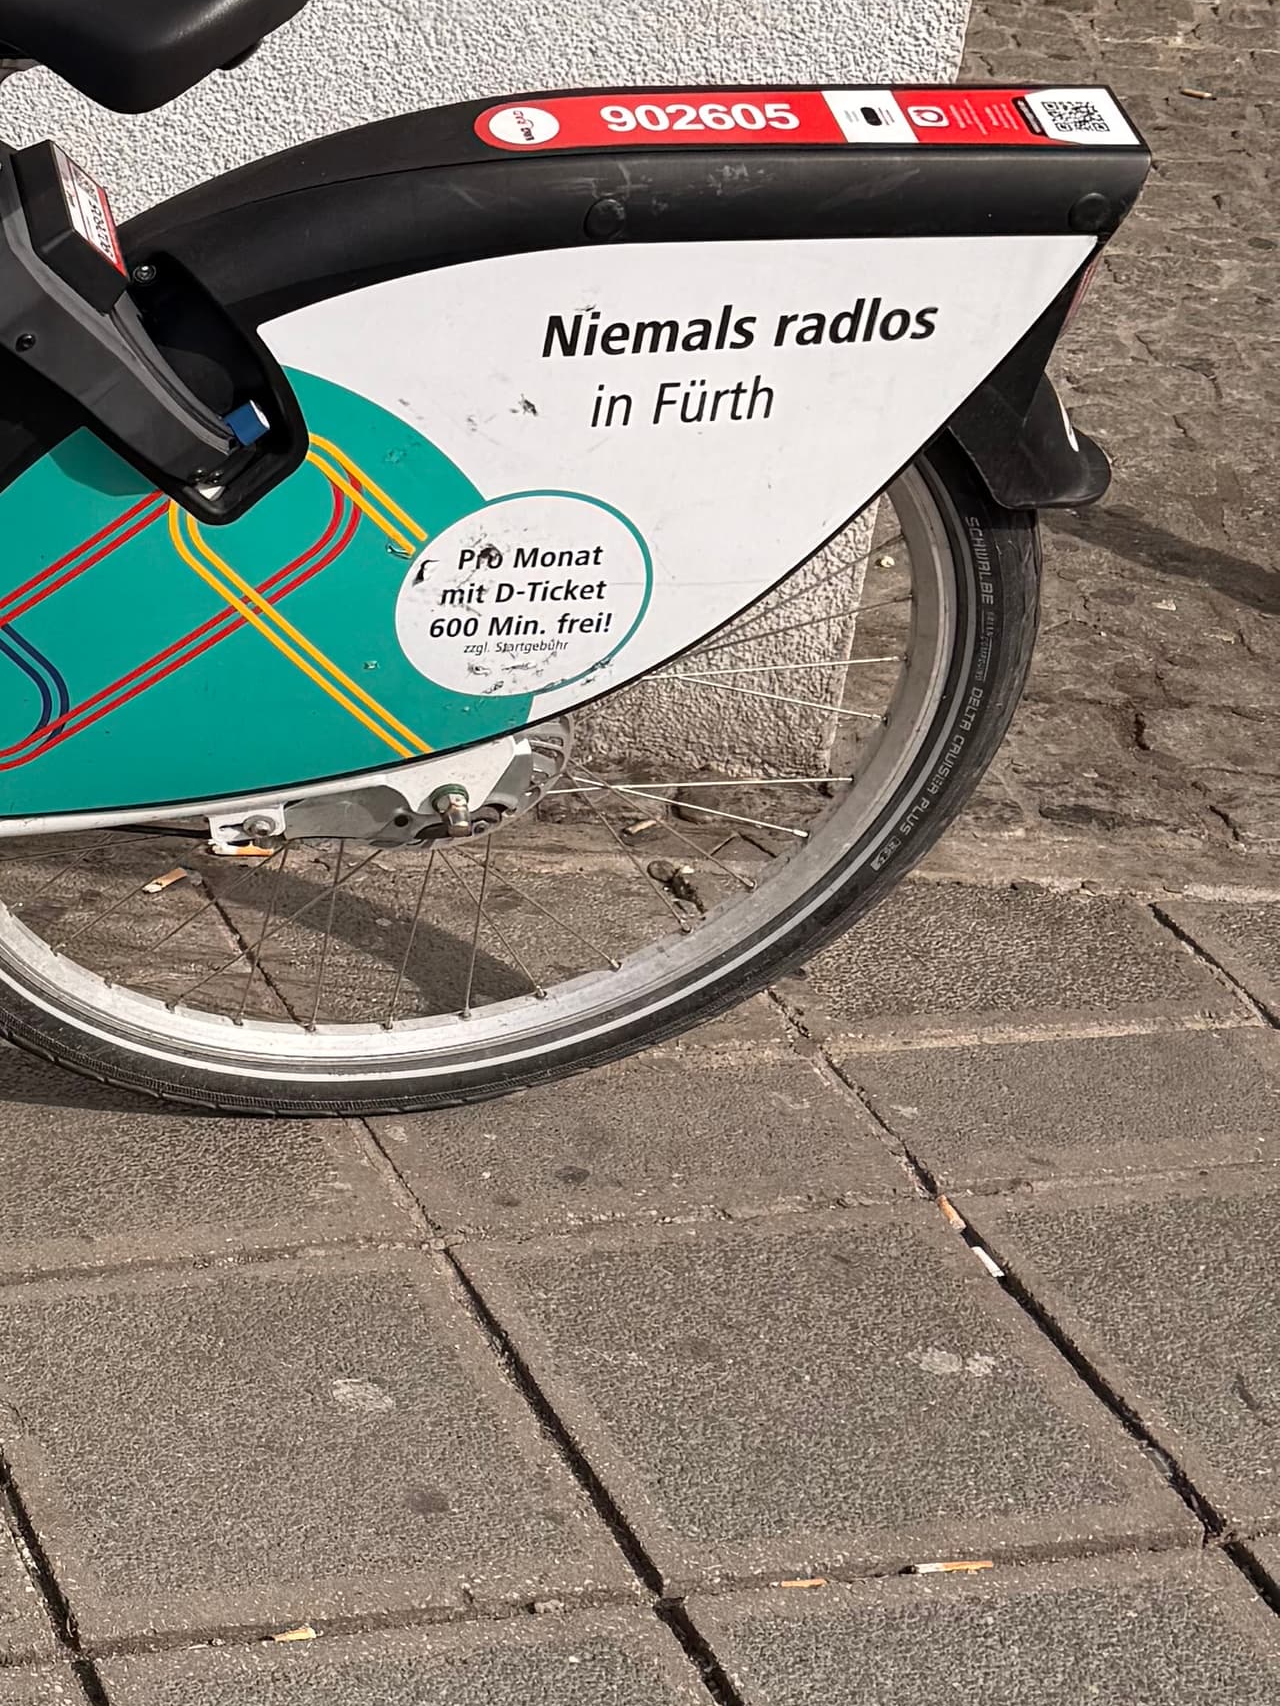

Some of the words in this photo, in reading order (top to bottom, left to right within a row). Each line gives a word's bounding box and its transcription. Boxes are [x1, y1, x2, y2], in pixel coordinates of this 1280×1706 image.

[600, 104, 800, 133] 902605
[541, 304, 757, 358] Niemals
[773, 297, 939, 347] radlos
[591, 384, 633, 428] in
[653, 375, 775, 425] Fürth
[458, 547, 503, 571] Pro
[513, 546, 604, 570] Monat
[965, 516, 995, 606] SCHWALBE
[439, 583, 486, 606] mit
[495, 579, 607, 603] D-Ticket
[429, 617, 479, 638] 600
[488, 615, 546, 637] Min.
[557, 612, 613, 634] frei!
[463, 642, 490, 656] zzgl.
[495, 639, 569, 654] Startgebühr
[960, 687, 984, 733] DELTA
[927, 736, 966, 796] CRUISER
[899, 798, 931, 836] PLUS
